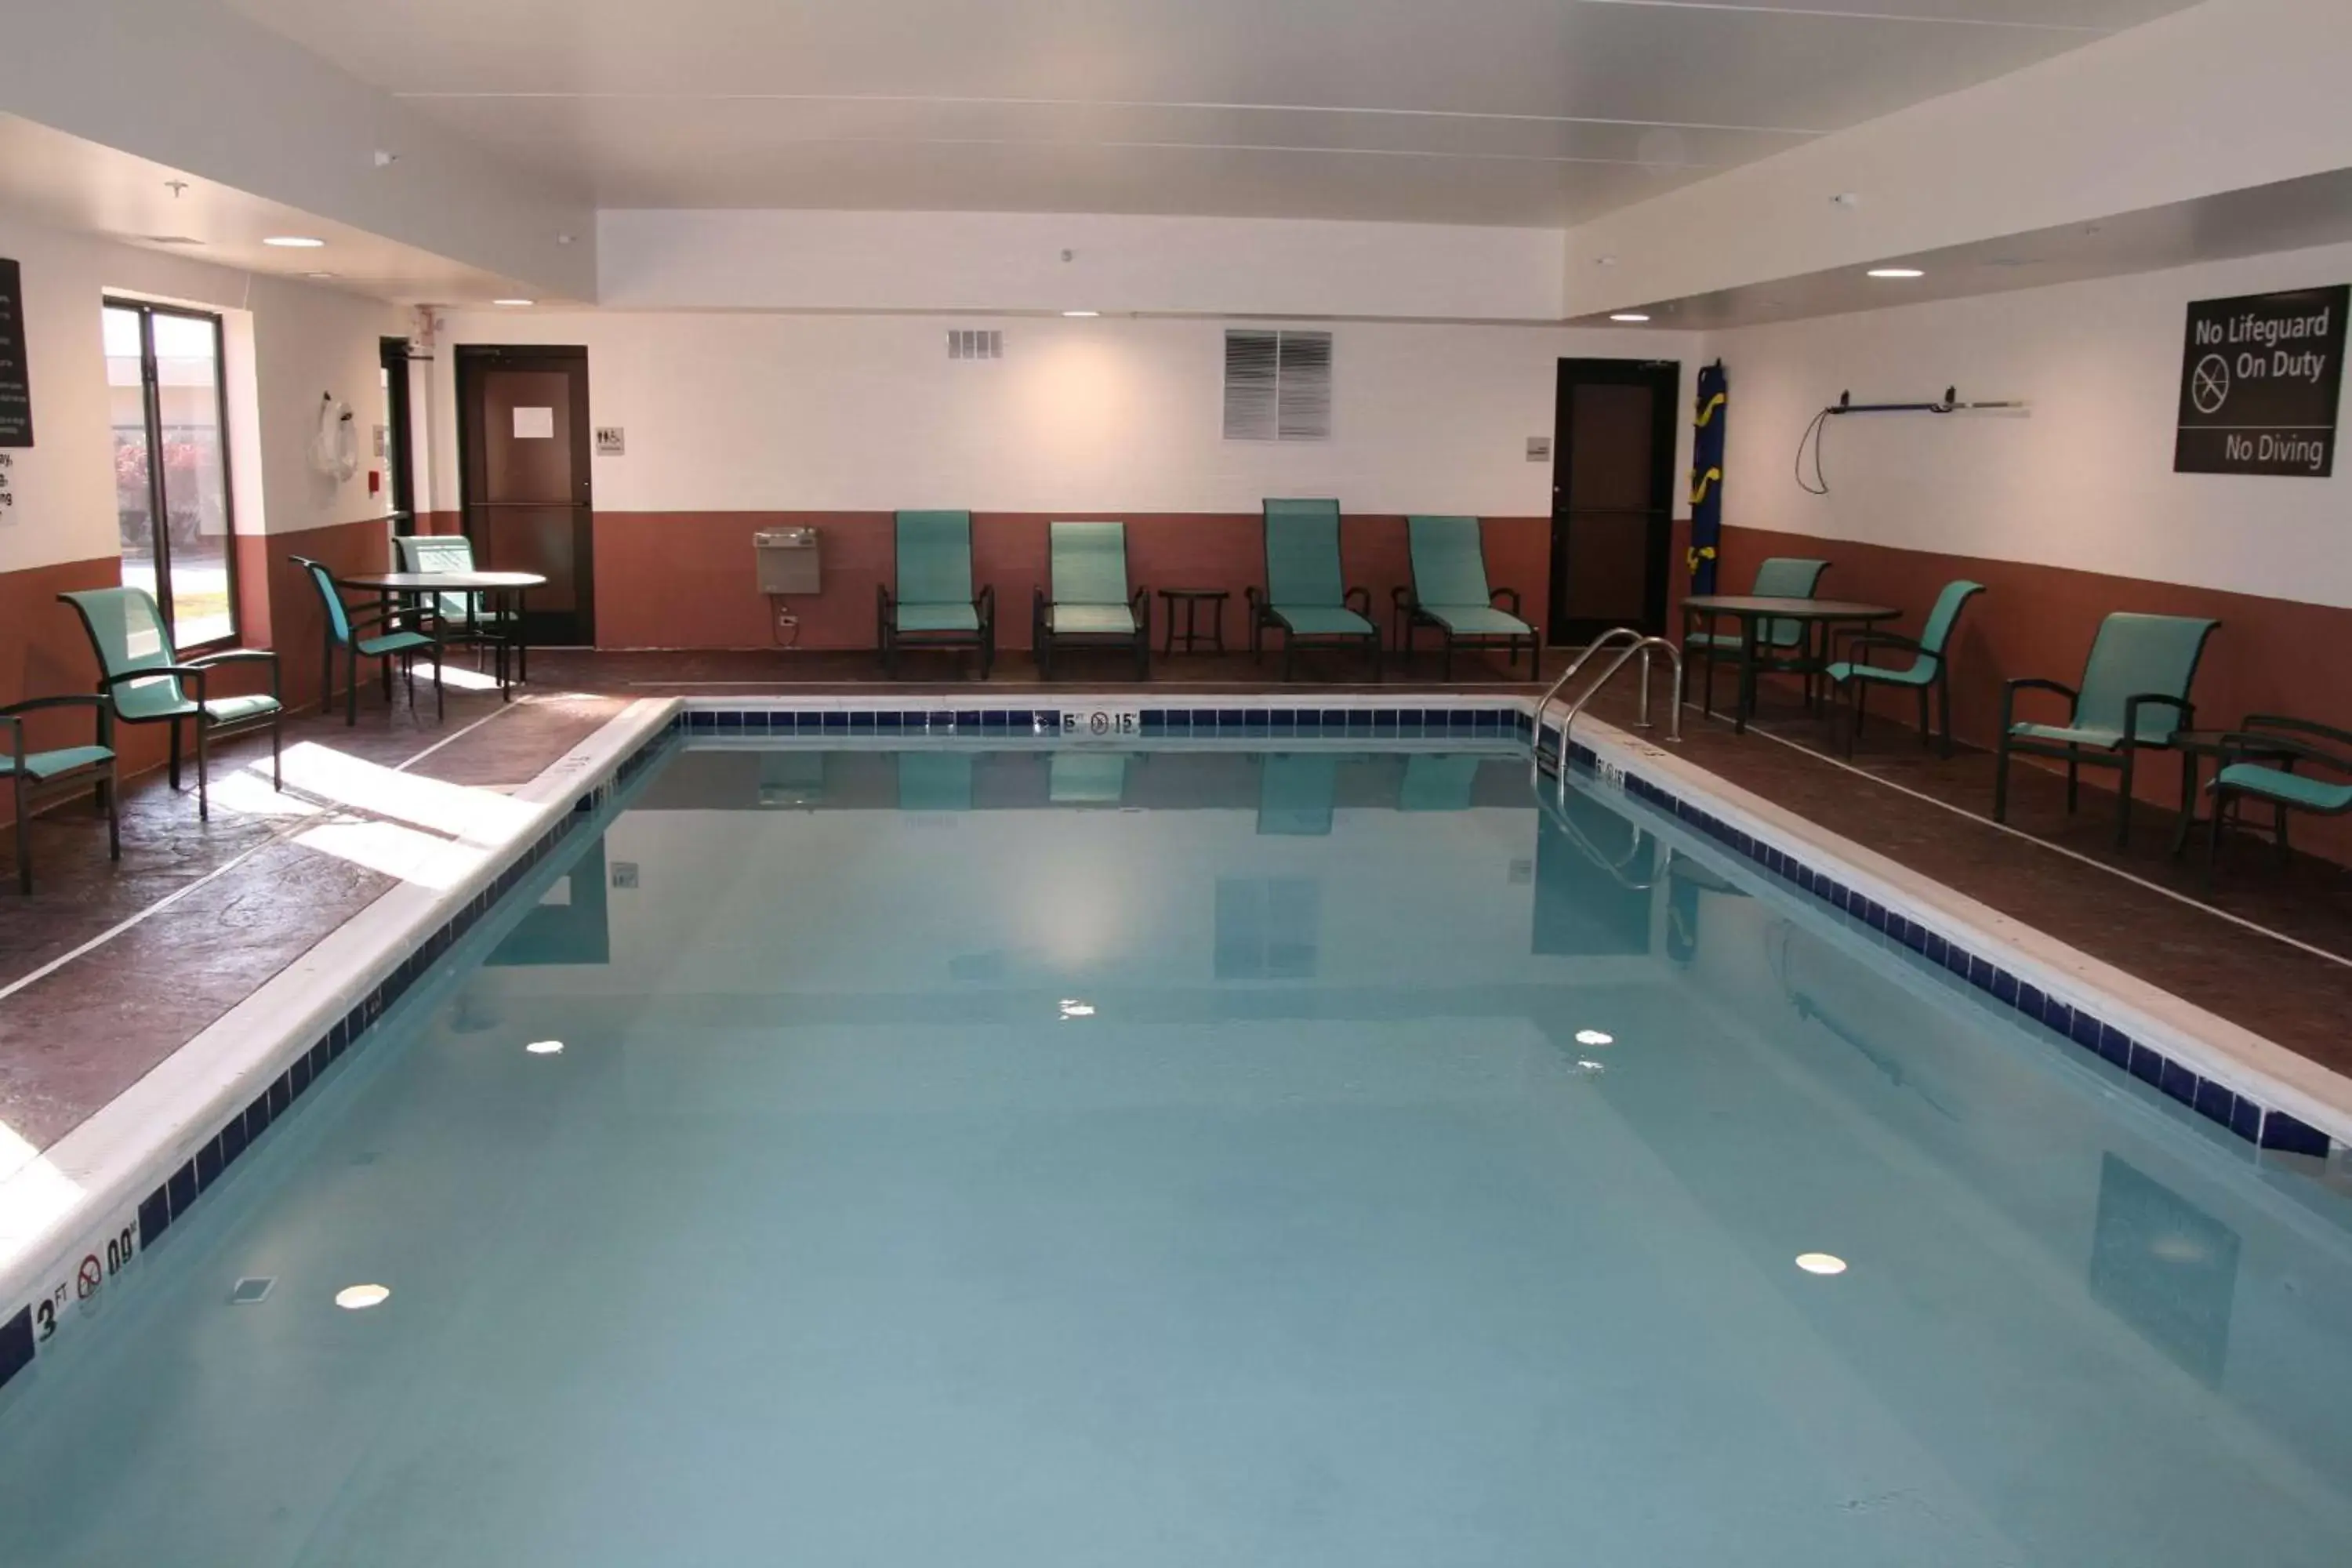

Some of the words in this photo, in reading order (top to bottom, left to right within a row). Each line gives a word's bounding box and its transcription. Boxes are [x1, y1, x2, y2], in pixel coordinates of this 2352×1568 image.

[2195, 318, 2223, 345] No
[2228, 306, 2330, 347] Lifeguard
[2236, 352, 2266, 379] On
[2273, 350, 2326, 383] Duty
[2225, 434, 2253, 461] No
[2258, 434, 2324, 470] Diving
[37, 1298, 57, 1343] 3
[54, 1281, 68, 1308] FT
